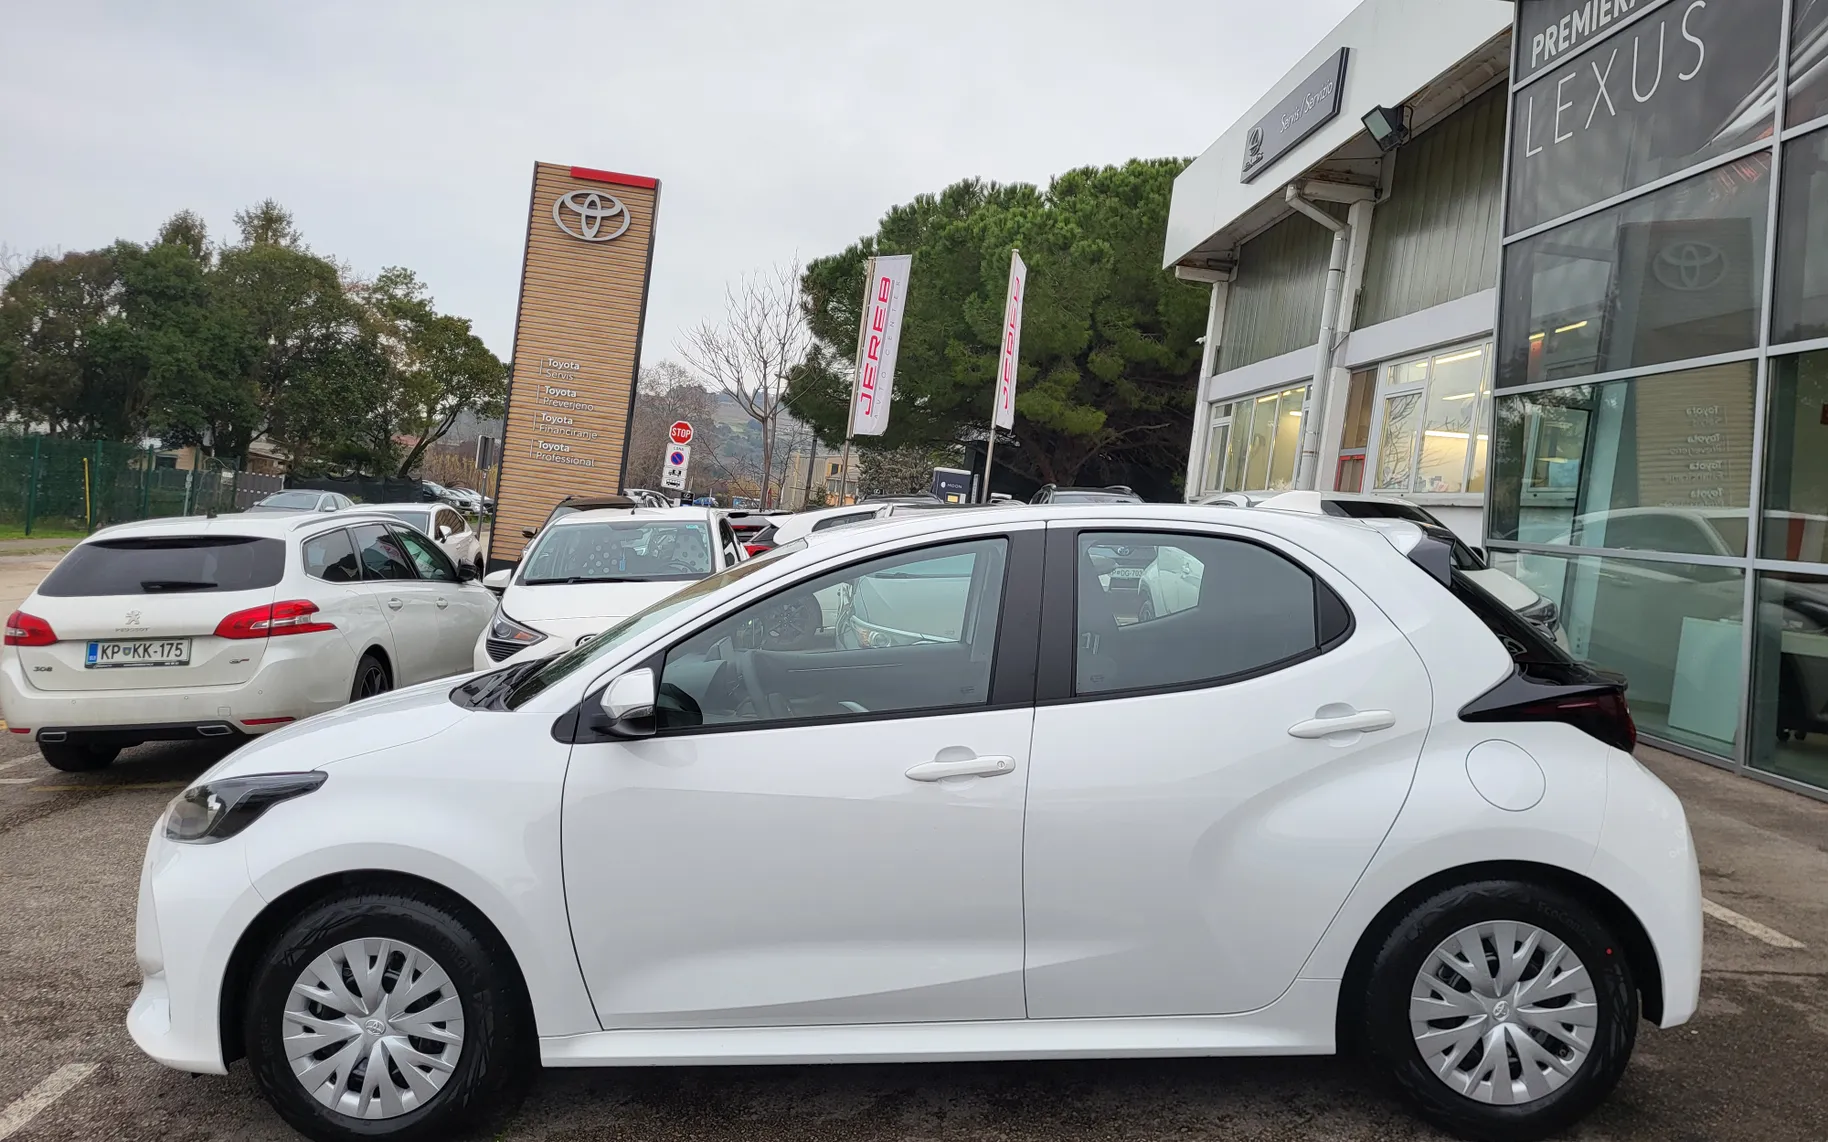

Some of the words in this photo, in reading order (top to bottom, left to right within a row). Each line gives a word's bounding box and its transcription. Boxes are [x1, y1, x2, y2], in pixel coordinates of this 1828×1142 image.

[1531, 0, 1636, 68] PREMIER
[1526, 1, 1706, 157] LEXUS
[860, 277, 891, 415] JEREB
[547, 358, 580, 370] Toyota
[545, 369, 574, 381] Servis
[544, 385, 577, 398] Toyota
[543, 397, 594, 412] Preverjeno
[541, 412, 573, 425] Toyota
[539, 424, 598, 441] Financiranje
[671, 427, 691, 438] STOP
[537, 439, 570, 452] Toyota
[535, 451, 595, 467] Professional
[100, 644, 120, 660] KP
[132, 642, 184, 659] KK-175
